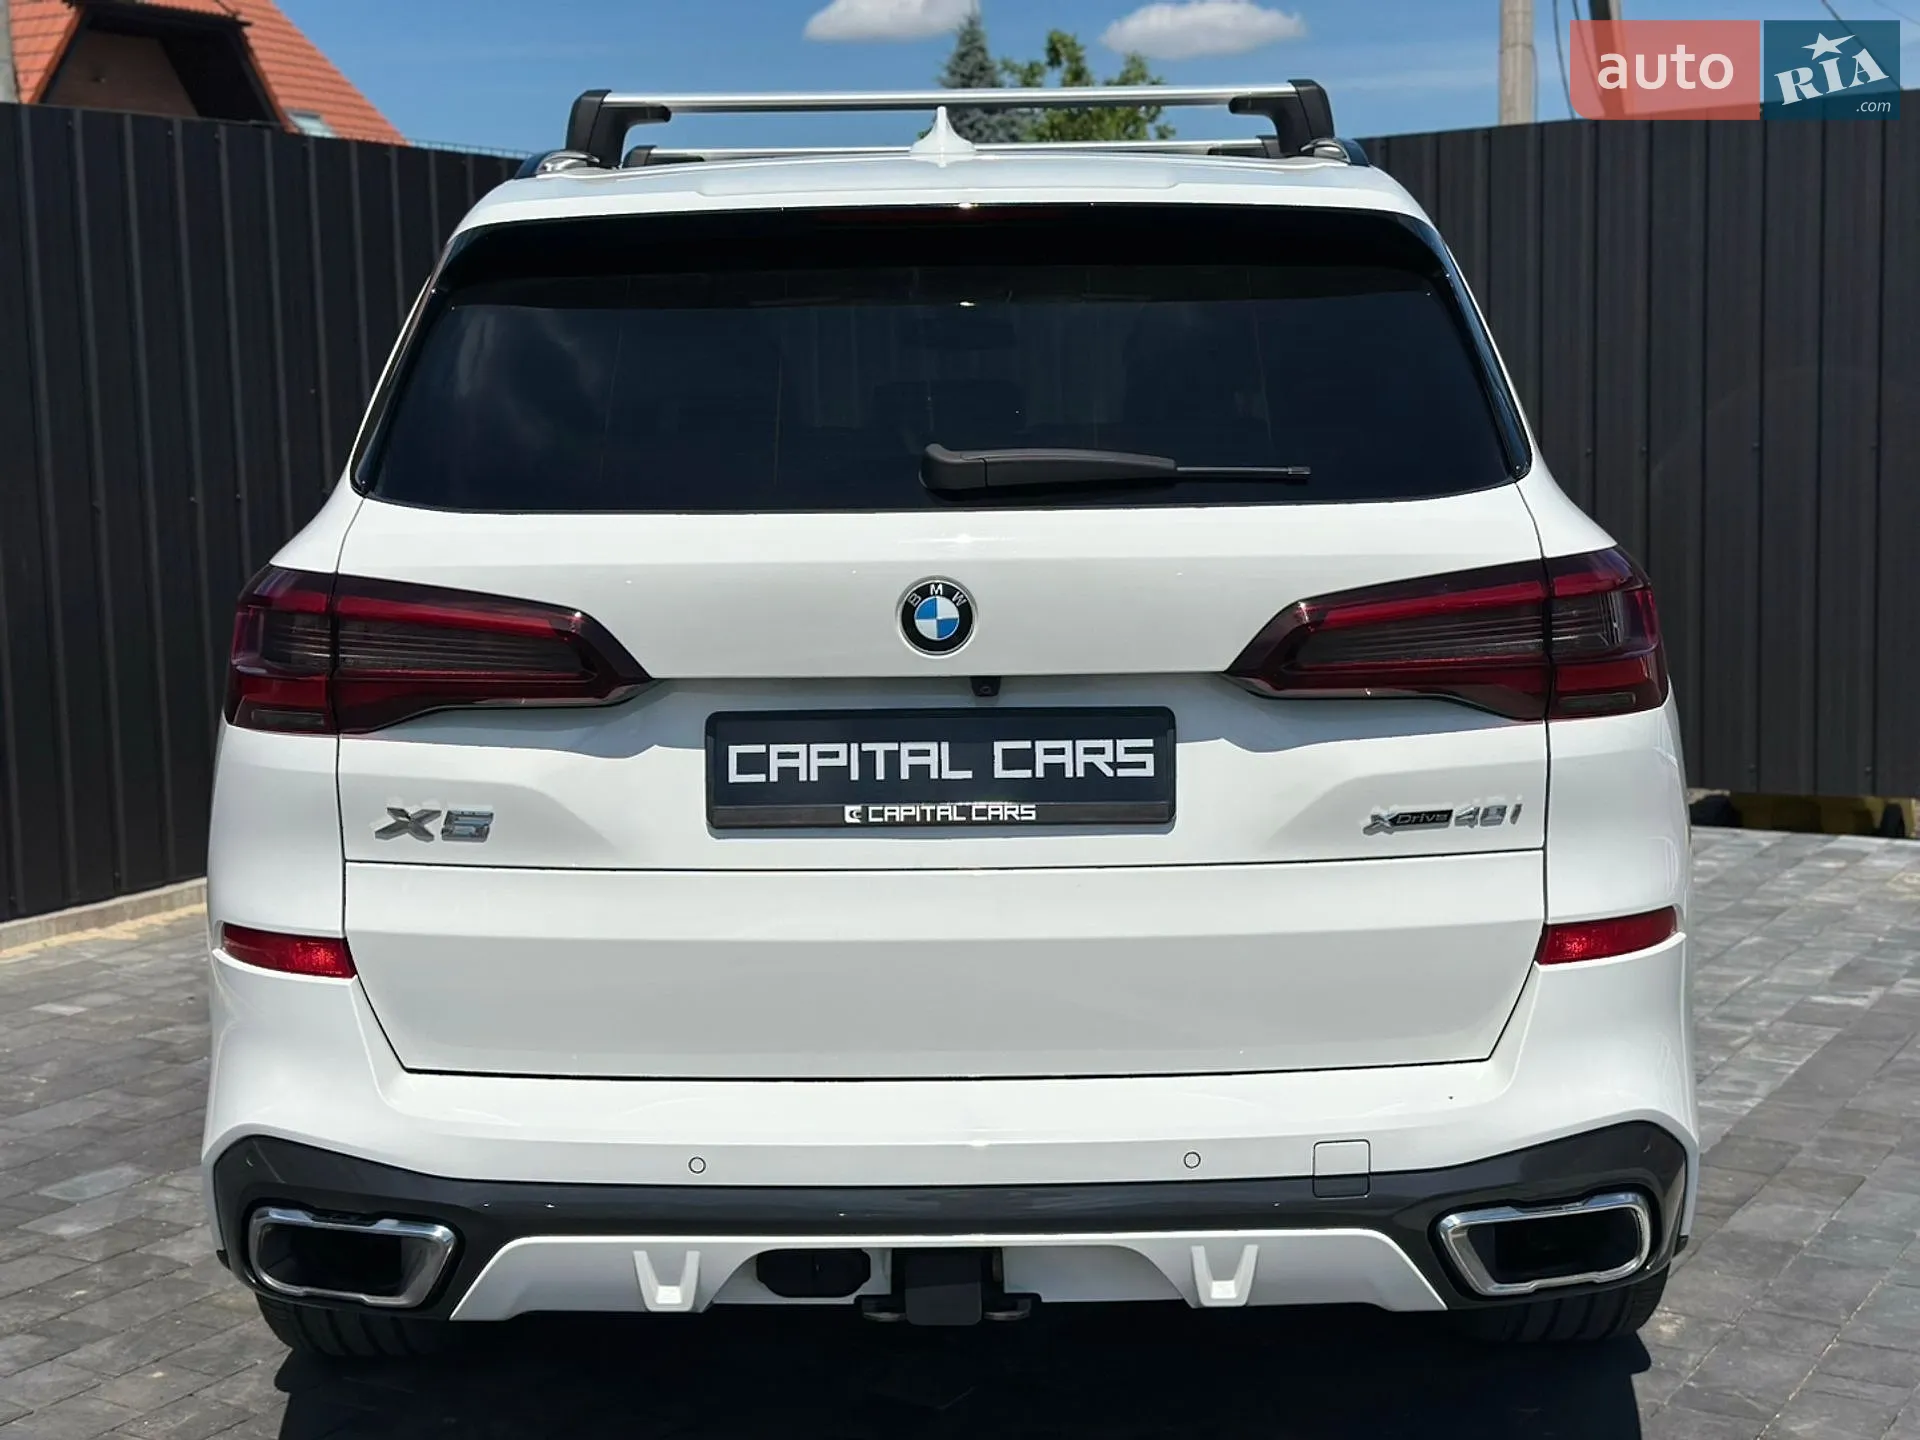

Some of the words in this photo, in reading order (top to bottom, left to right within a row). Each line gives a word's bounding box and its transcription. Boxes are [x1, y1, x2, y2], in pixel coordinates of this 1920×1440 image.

[907, 583, 968, 608] BMW
[727, 741, 973, 783] CAPITAL
[993, 738, 1155, 780] CARS
[374, 806, 495, 843] X5
[868, 804, 967, 823] CAPITAL
[971, 803, 1037, 821] CARS
